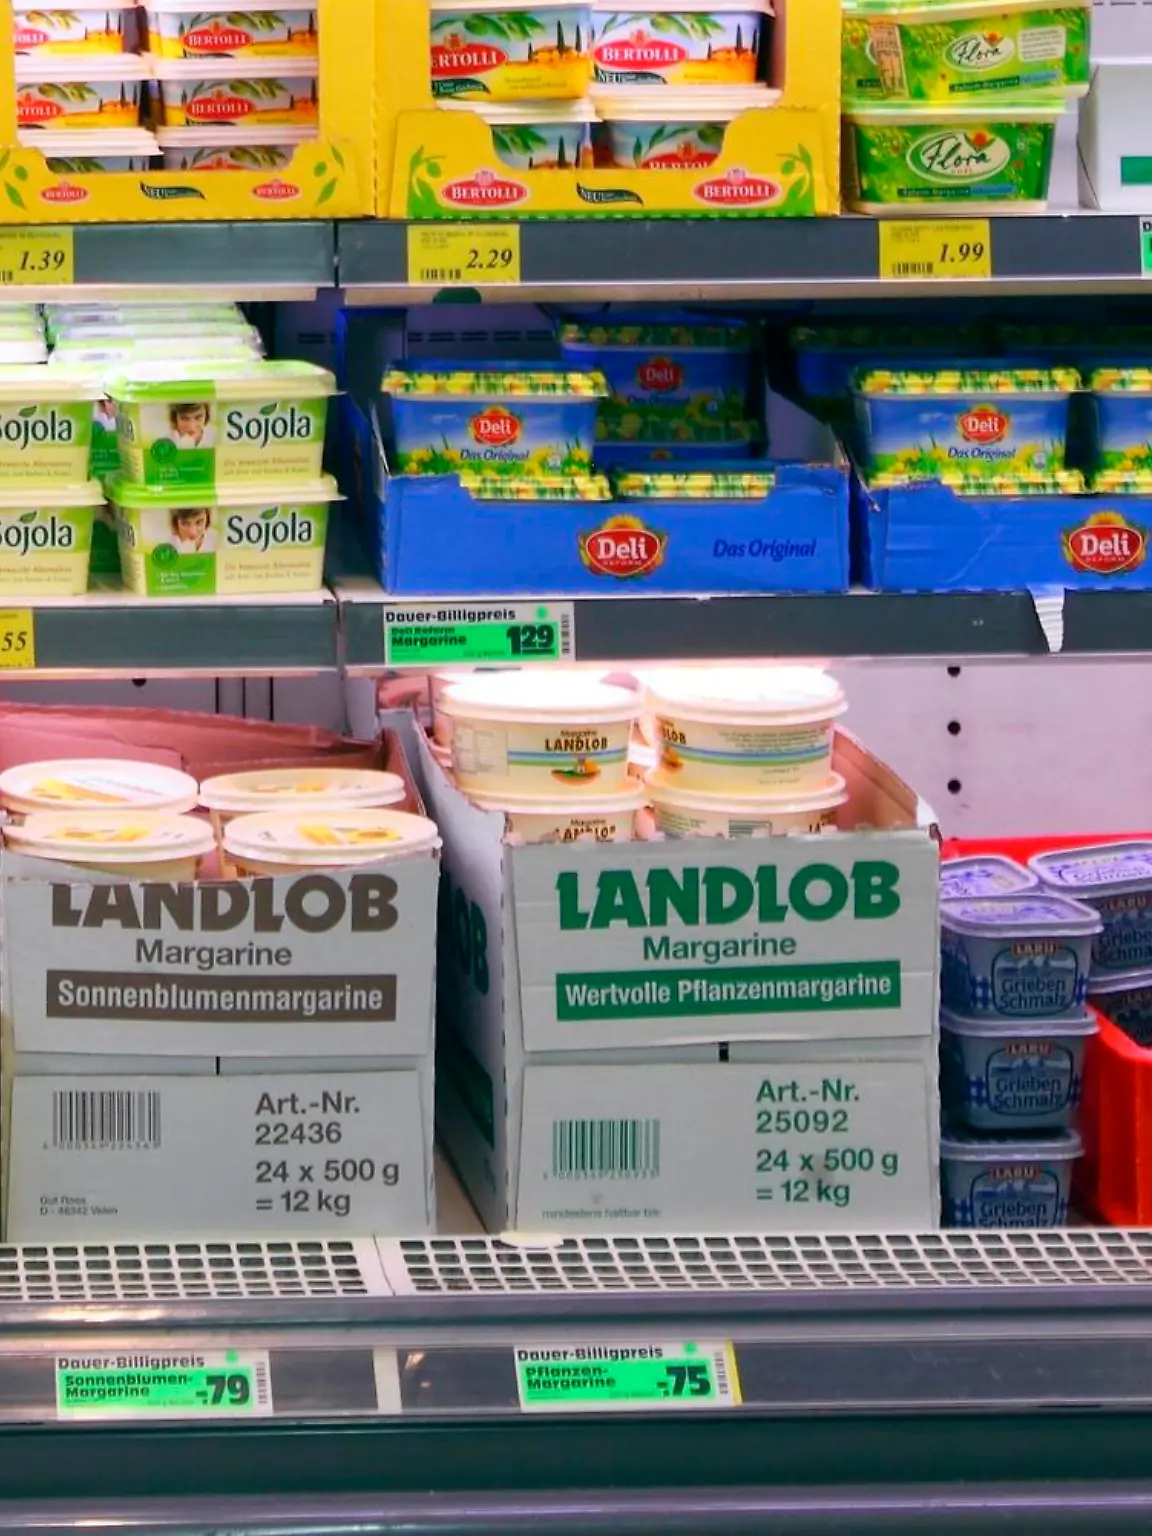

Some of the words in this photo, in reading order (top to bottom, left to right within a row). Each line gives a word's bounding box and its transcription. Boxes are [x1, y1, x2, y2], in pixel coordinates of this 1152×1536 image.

[188, 32, 248, 48] BERTOLLI
[601, 47, 680, 62] BERTOLLI
[191, 101, 250, 116] BERTOLLI
[451, 185, 519, 200] BERTOLLI
[703, 183, 773, 198] BERTOLLI
[19, 250, 65, 271] 1.39
[466, 249, 513, 270] 2.29
[938, 243, 984, 263] 1.99
[645, 367, 675, 383] Deli
[478, 419, 512, 435] Deli
[967, 417, 1000, 432] Deli
[460, 449, 482, 462] Das
[483, 450, 530, 464] Original
[947, 447, 970, 459] Das
[971, 448, 1016, 461] Original
[226, 513, 313, 552] Sojola
[596, 536, 647, 561] Deli
[713, 539, 747, 558] Das
[751, 538, 816, 562] Original
[1080, 534, 1131, 557] Deli
[385, 609, 516, 623] Dauer-Billigpreis
[391, 635, 467, 647] Margarine
[544, 736, 608, 752] LANDLOB
[51, 874, 399, 934] LANDLOB
[555, 859, 902, 931] LANDLOB
[135, 939, 293, 971] Margarine
[642, 935, 797, 965] Margarine
[564, 980, 671, 1009] Wertvolle
[677, 972, 893, 1004] Pflanzenmargarine
[1001, 977, 1066, 995] Grieben
[58, 979, 384, 1016] Sonnenblumenmargarine
[998, 993, 1066, 1012] Schmalz
[756, 1077, 861, 1103] Art.-Nr.
[995, 1075, 1061, 1093] Grieben
[255, 1090, 361, 1116] Art.-Nr.
[755, 1109, 849, 1134] 25092
[254, 1122, 343, 1146] 22436
[756, 1148, 789, 1172] 24
[799, 1154, 814, 1172] x
[823, 1147, 874, 1172] 500
[881, 1152, 899, 1177] g
[255, 1160, 290, 1183] 24
[299, 1165, 314, 1182] x
[323, 1159, 376, 1182] 500
[382, 1164, 401, 1187] g
[781, 1179, 810, 1203] 12
[816, 1178, 850, 1207] kg
[280, 1190, 311, 1213] 12
[317, 1188, 351, 1217] kg
[58, 1356, 205, 1371] Dauer-Billigpreis
[517, 1346, 664, 1362] Dauer-Billigpreis
[65, 1373, 194, 1387] Sonnenblumen-
[527, 1377, 616, 1390] Margarine
[65, 1385, 150, 1399] Margarine
